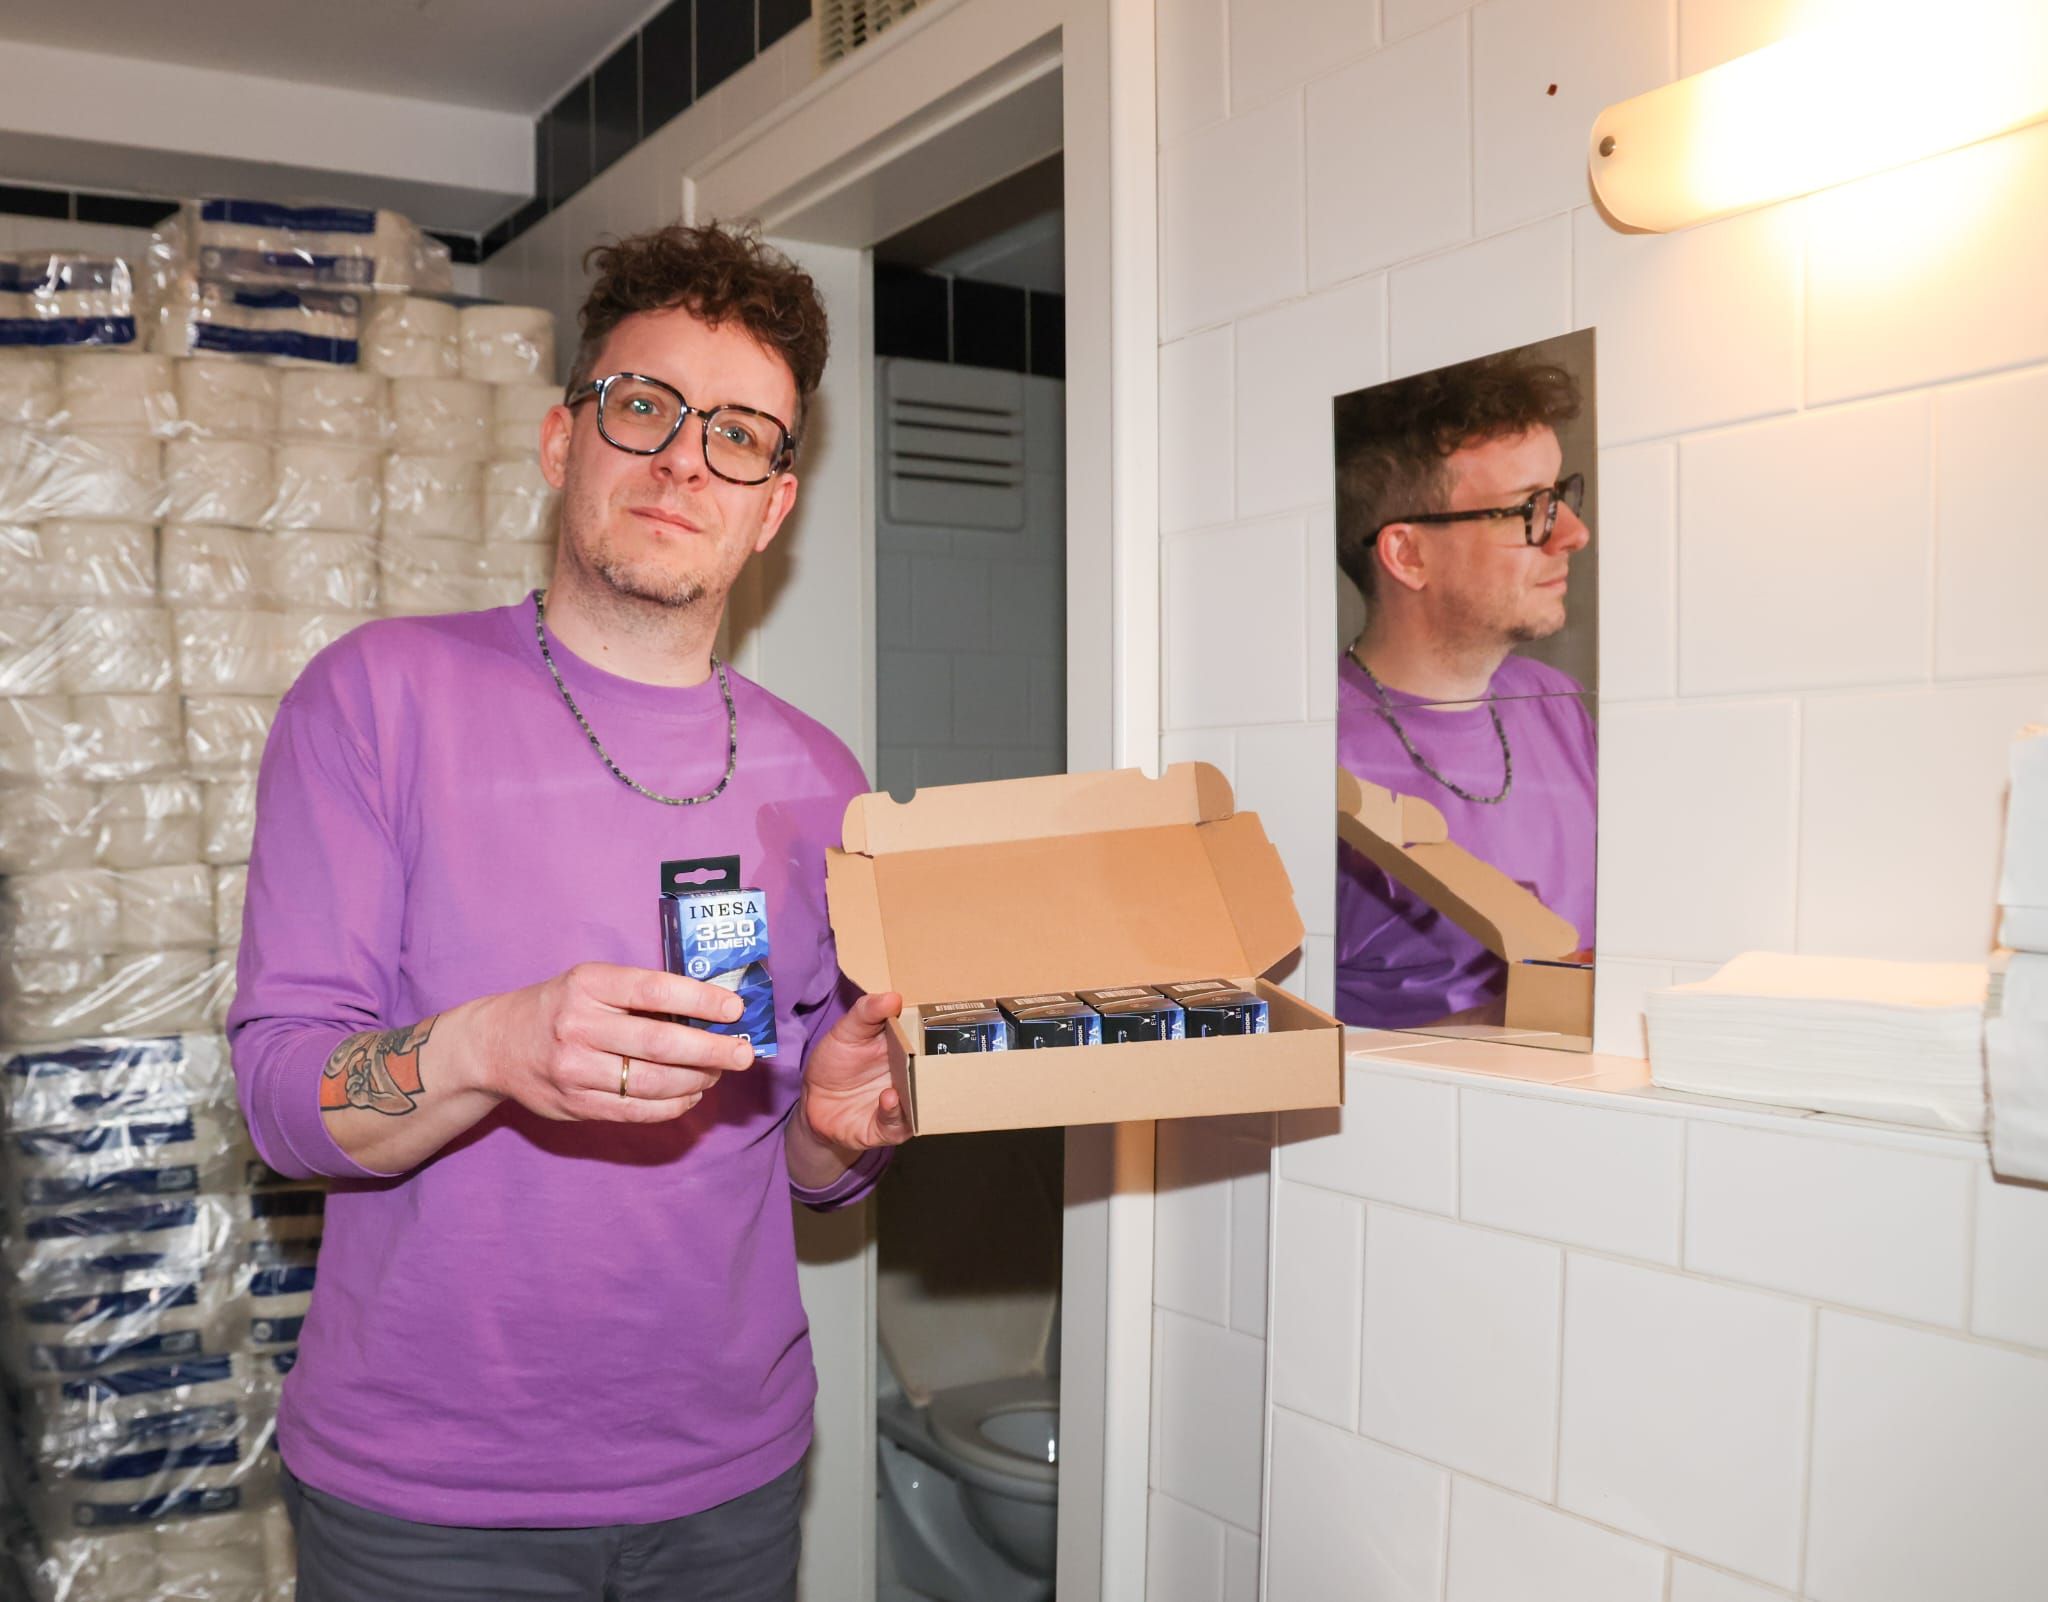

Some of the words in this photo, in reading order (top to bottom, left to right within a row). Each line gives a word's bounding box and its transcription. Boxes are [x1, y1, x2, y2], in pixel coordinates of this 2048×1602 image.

[689, 901, 758, 919] INESA
[695, 919, 755, 941] 320
[697, 936, 757, 952] LUMEN
